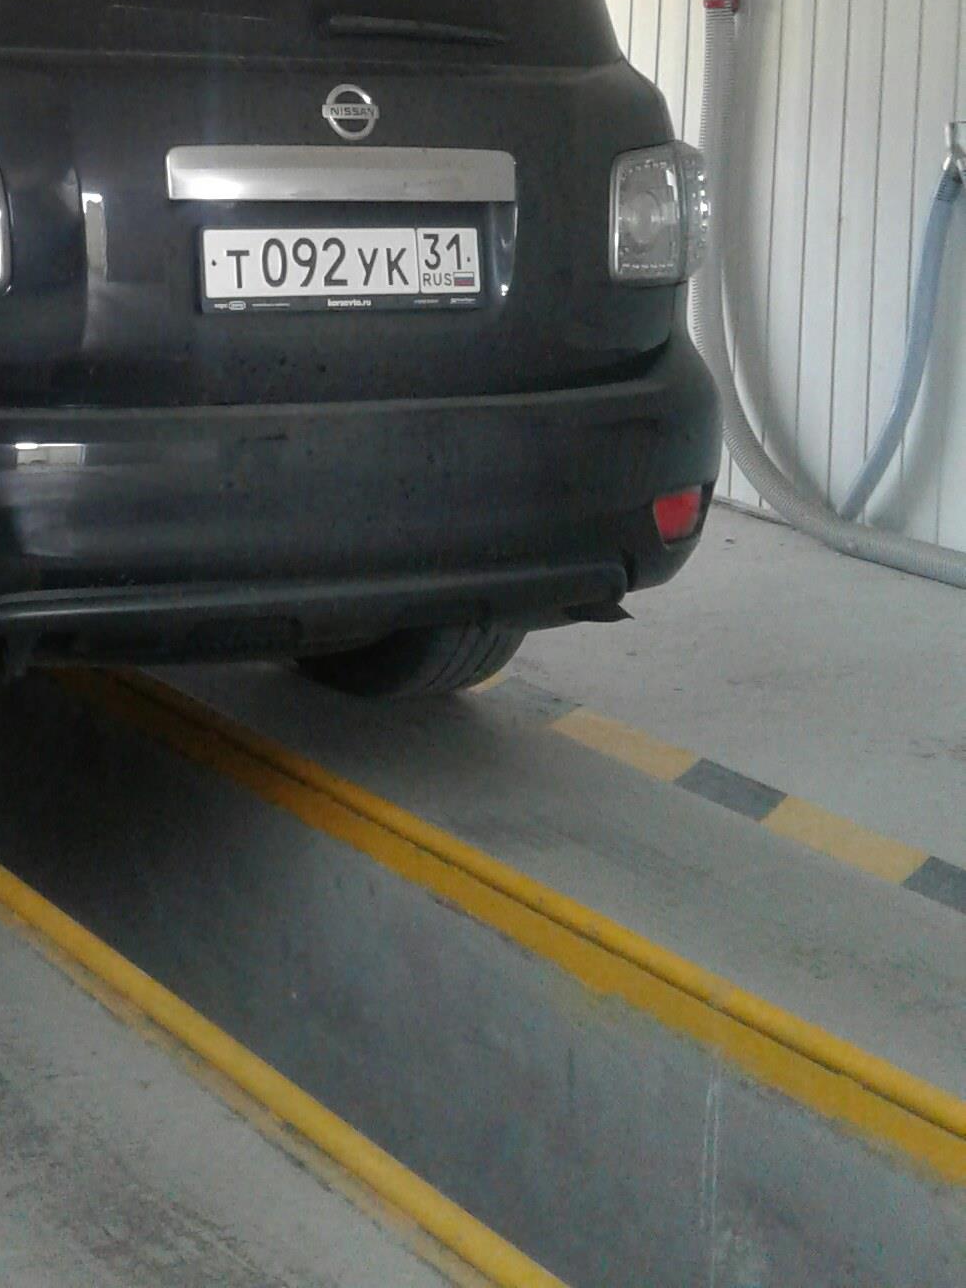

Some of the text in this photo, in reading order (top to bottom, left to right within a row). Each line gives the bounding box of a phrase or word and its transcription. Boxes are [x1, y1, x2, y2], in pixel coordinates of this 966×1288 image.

[330, 107, 375, 117] NISSAN
[422, 233, 462, 270] 31
[422, 272, 452, 287] RUS
